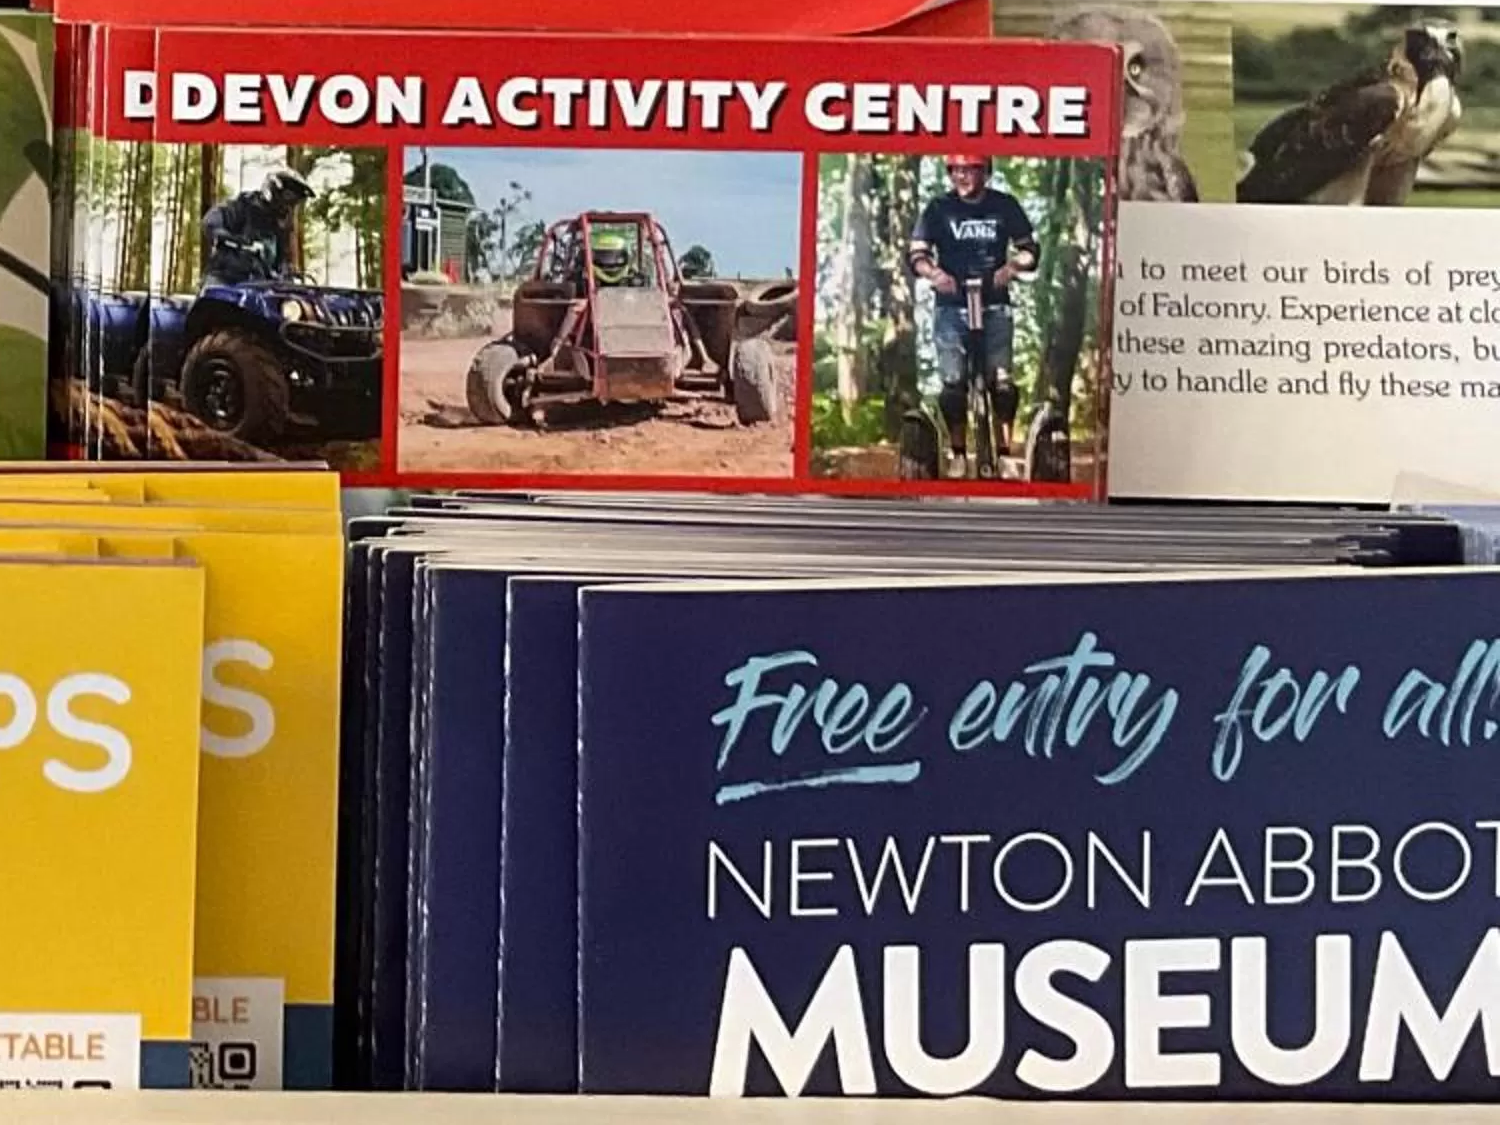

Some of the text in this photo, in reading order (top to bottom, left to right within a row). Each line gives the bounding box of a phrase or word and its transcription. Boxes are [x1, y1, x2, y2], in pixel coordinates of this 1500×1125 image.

[172, 72, 1090, 138] DEVON ACTIVITY CENTRE
[1141, 258, 1165, 280] to
[1182, 260, 1247, 282] meet
[1263, 265, 1308, 283] our
[1324, 259, 1390, 285] birds
[1405, 261, 1433, 286] of
[1119, 293, 1147, 316] of
[1152, 293, 1271, 325] Falconry.
[1280, 296, 1430, 325] Experience
[1437, 301, 1462, 323] at
[1117, 328, 1185, 355] these
[1198, 333, 1311, 363] amazing
[1324, 335, 1459, 364] predators,
[1142, 369, 1167, 392] to
[1177, 368, 1268, 394] handle
[1277, 371, 1329, 395] and
[1338, 372, 1371, 402] fly
[1380, 373, 1450, 398] these
[711, 650, 929, 772] Free
[948, 631, 1179, 785] entry
[1211, 644, 1360, 782] for
[707, 830, 1151, 920] NEWTON
[708, 925, 1500, 1098] MUSEUM
